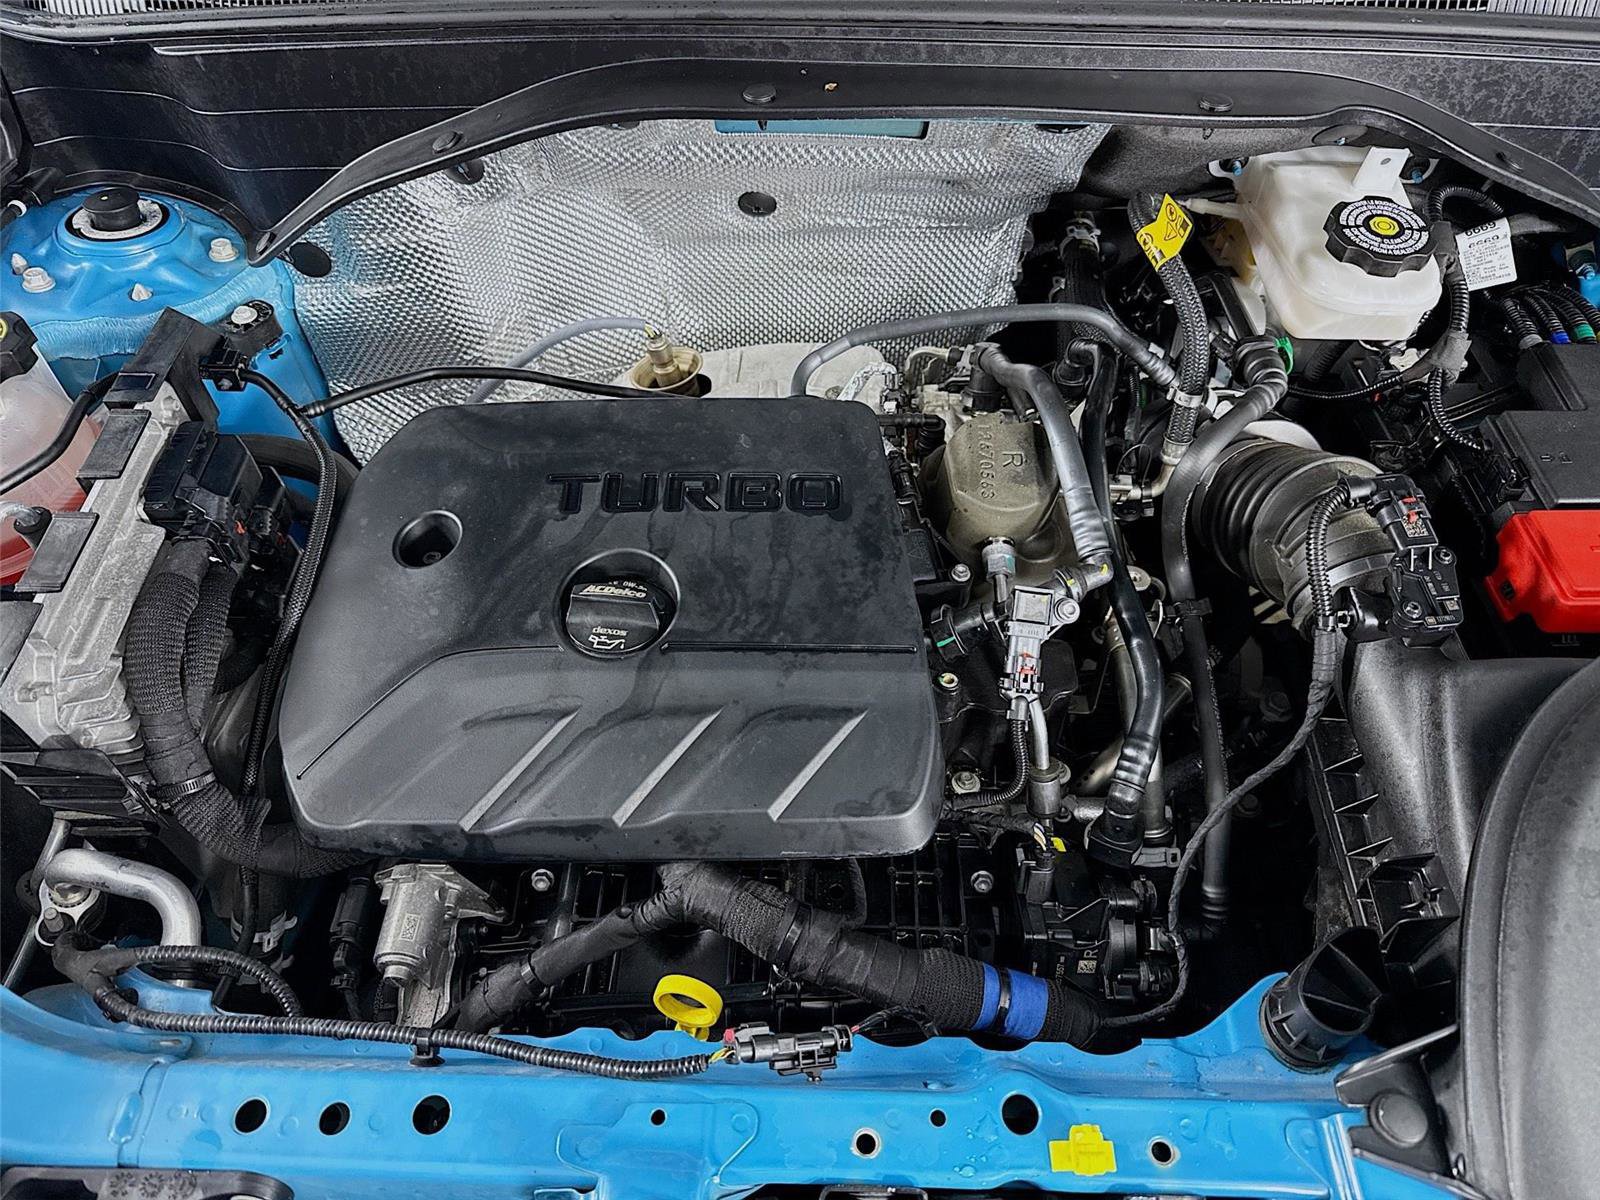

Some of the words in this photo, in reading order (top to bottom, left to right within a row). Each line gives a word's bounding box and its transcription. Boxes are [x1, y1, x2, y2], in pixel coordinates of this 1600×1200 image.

[1369, 245, 1388, 254] FROM
[547, 471, 842, 514] TURBO
[580, 584, 647, 599] ACDelco
[592, 625, 628, 636] dexos
